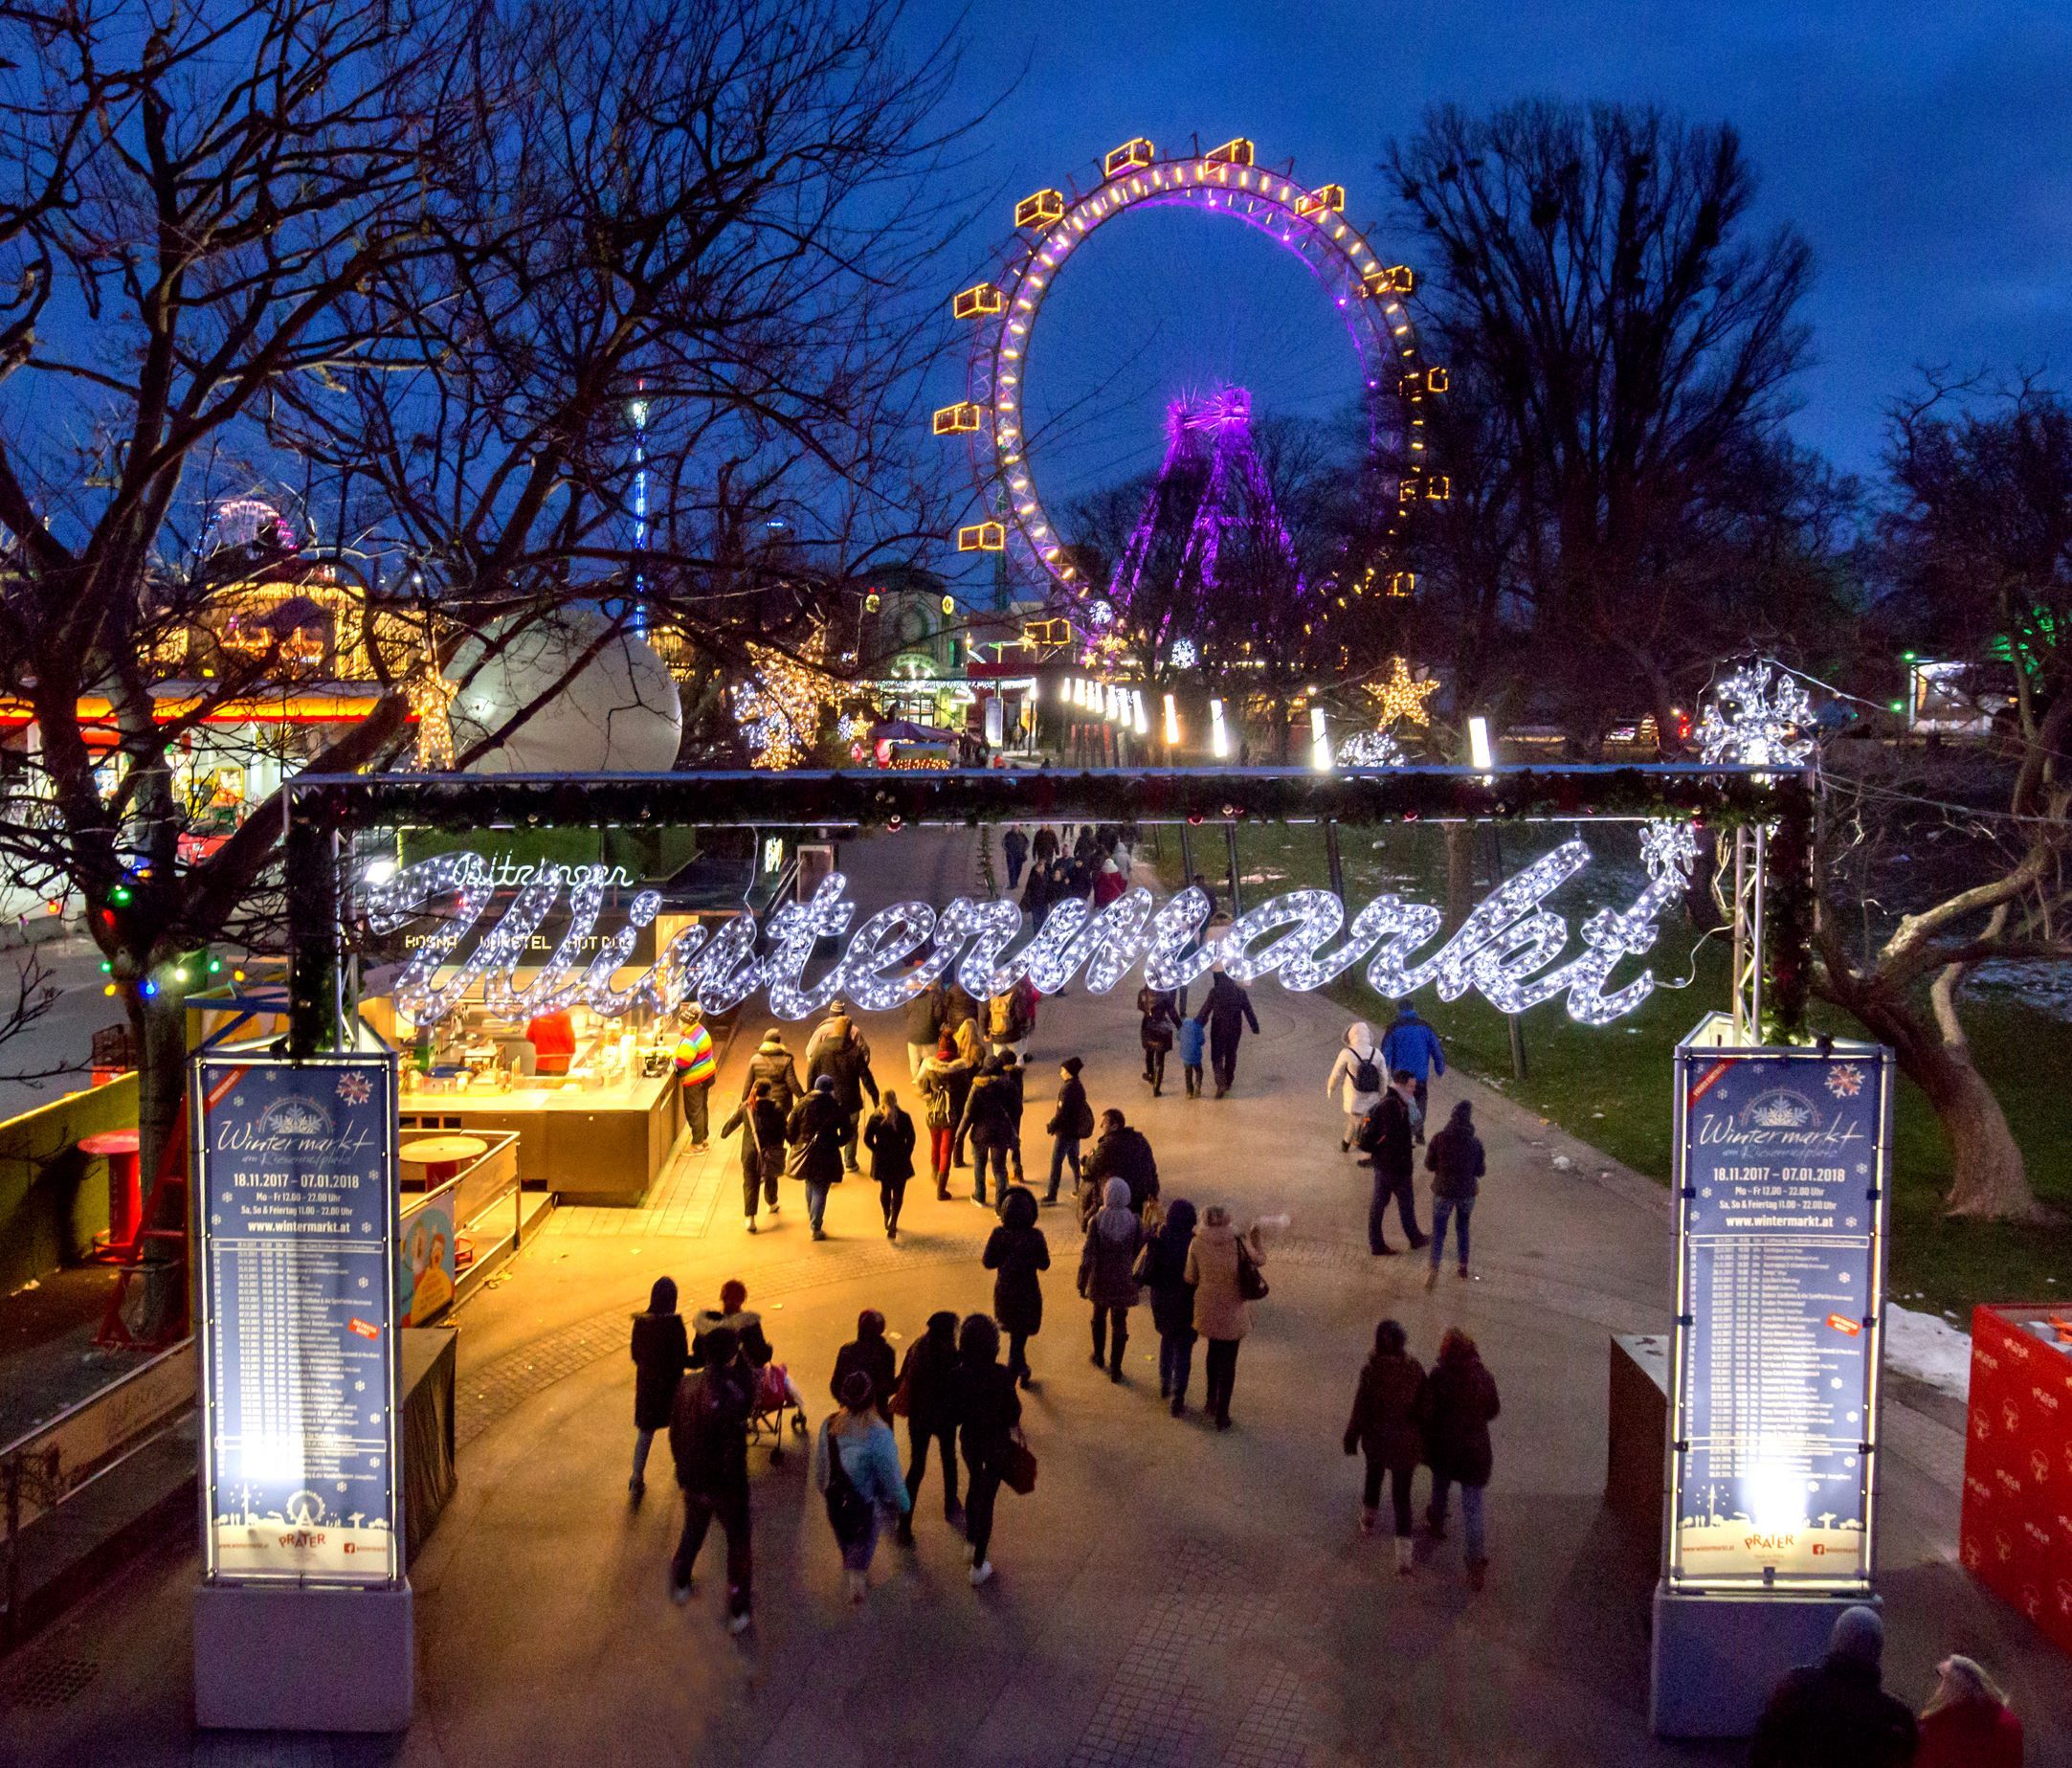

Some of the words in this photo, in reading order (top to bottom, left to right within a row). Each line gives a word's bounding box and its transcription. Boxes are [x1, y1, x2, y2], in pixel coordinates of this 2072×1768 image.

[368, 837, 1694, 1027] Wintermarkt
[1699, 1111, 1865, 1148] Wintermarkt
[217, 1118, 375, 1157] Wintermarkt
[234, 1173, 289, 1187] 18.11.2017
[301, 1175, 360, 1189] 07.01.2018
[1713, 1167, 1771, 1181] 18.11.2017
[1782, 1168, 1845, 1182] 07.01.2018
[256, 1192, 267, 1201] Mo
[274, 1193, 280, 1201] Fr
[282, 1193, 301, 1202] 12.00
[307, 1193, 327, 1202] 22.00
[328, 1193, 342, 1202] Uhr
[1753, 1186, 1761, 1196] Fr
[1789, 1186, 1810, 1196] 22.00
[1811, 1187, 1825, 1196] Uhr
[269, 1205, 298, 1217] Feiertag
[321, 1206, 340, 1216] 22.00
[341, 1206, 353, 1216] Uhr
[1748, 1199, 1777, 1211] Feiertag
[1823, 1200, 1838, 1210] Uhr
[248, 1220, 350, 1233] www.wintermarkt.at
[1726, 1214, 1834, 1227] www.wintermarkt.at
[278, 1533, 325, 1548] PRATER
[1744, 1533, 1794, 1550] PRATER
